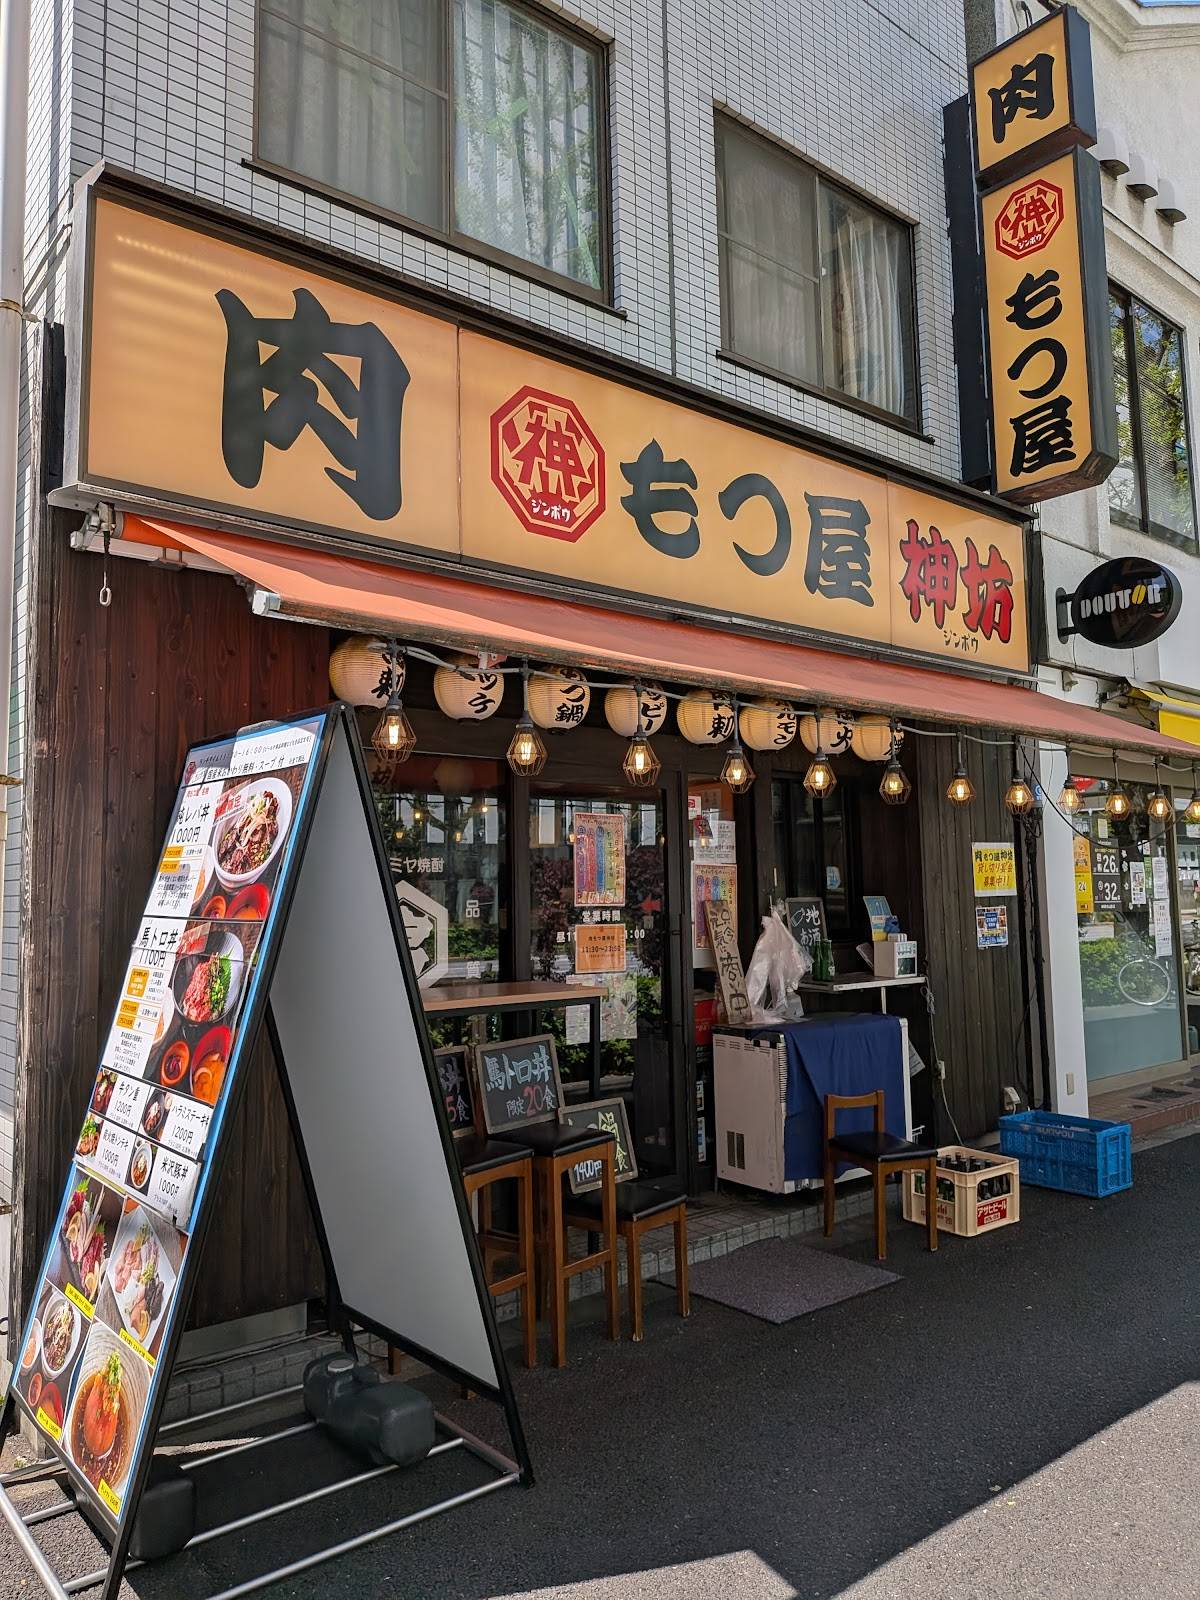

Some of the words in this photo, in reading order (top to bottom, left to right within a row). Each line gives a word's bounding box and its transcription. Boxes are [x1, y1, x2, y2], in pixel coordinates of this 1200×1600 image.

[988, 53, 1054, 143] 肉
[1005, 269, 1076, 477] もつ屋
[215, 288, 411, 520] 肉
[620, 439, 873, 607] もつ屋
[899, 518, 1013, 644] 神坊
[1080, 583, 1161, 619] DOUTOR
[172, 826, 200, 843] 1000円
[581, 910, 621, 923] 営業時間
[139, 926, 178, 950] 馬トロ丼
[484, 1045, 552, 1092] 馬トロ丼
[977, 1201, 1007, 1217] アサヒビール
